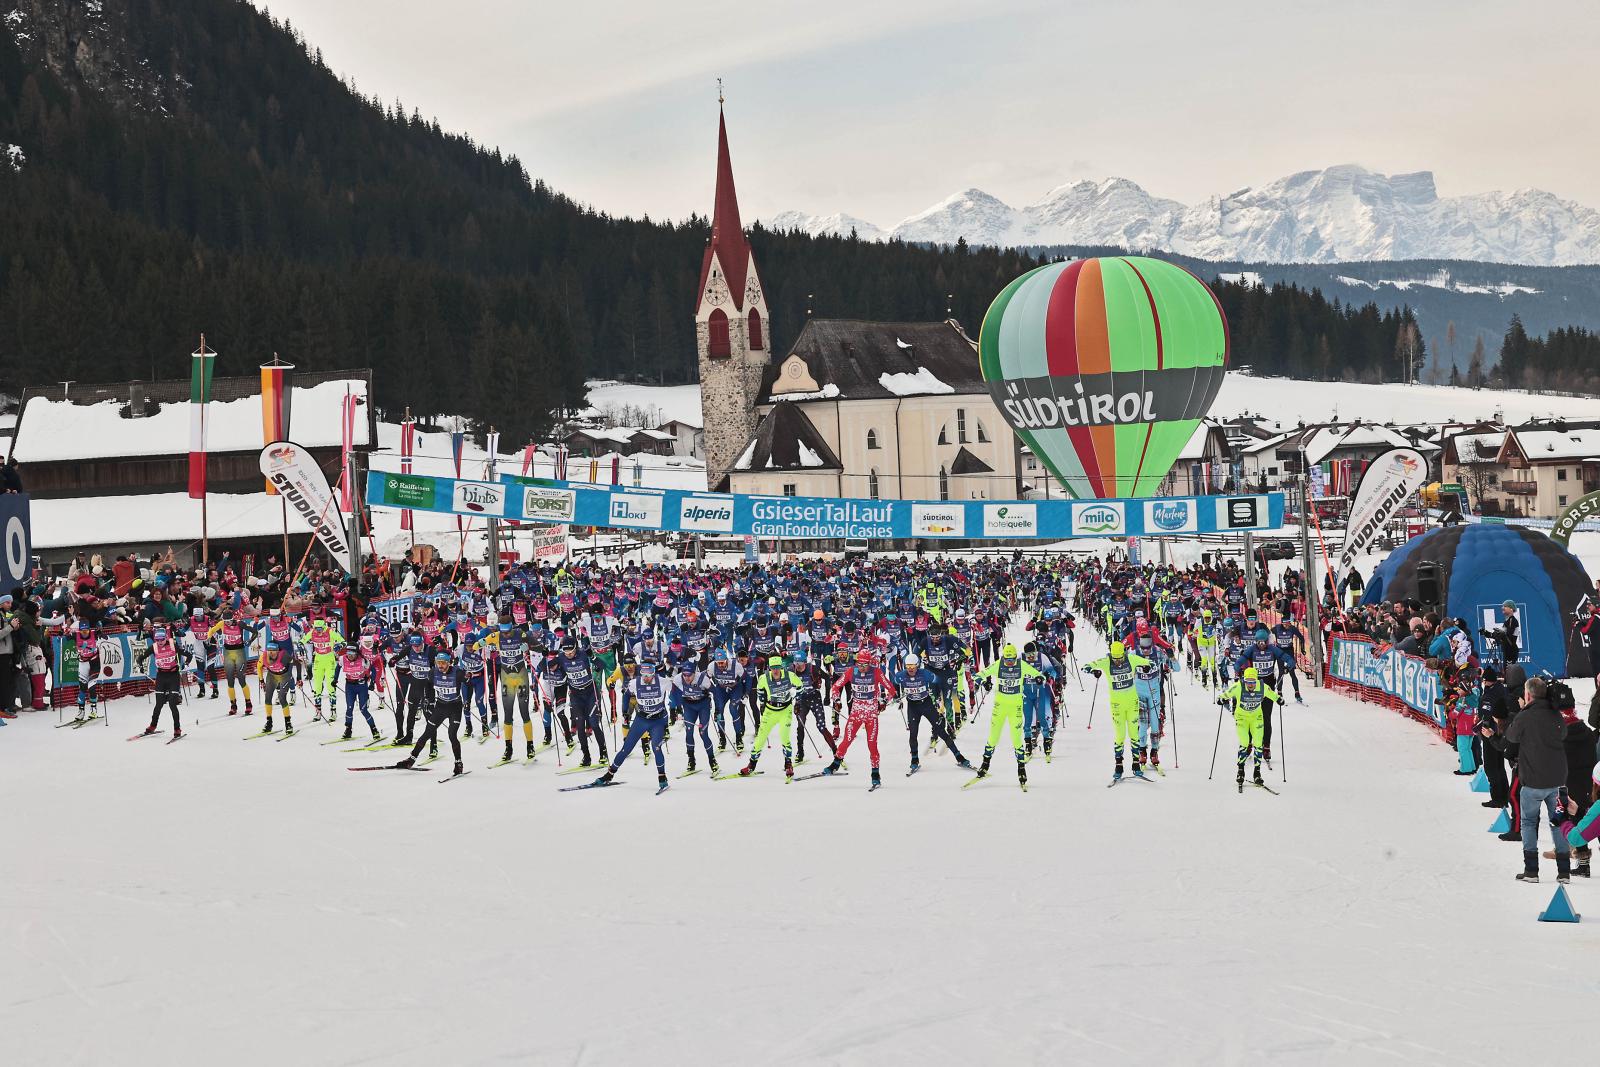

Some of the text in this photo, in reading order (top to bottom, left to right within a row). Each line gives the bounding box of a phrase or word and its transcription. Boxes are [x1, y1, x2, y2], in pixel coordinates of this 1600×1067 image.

[399, 483, 430, 491] Raiffeisen
[530, 498, 569, 511] FORST
[684, 506, 730, 522] alperia
[1085, 511, 1114, 523] mila
[1556, 497, 1598, 537] FORST
